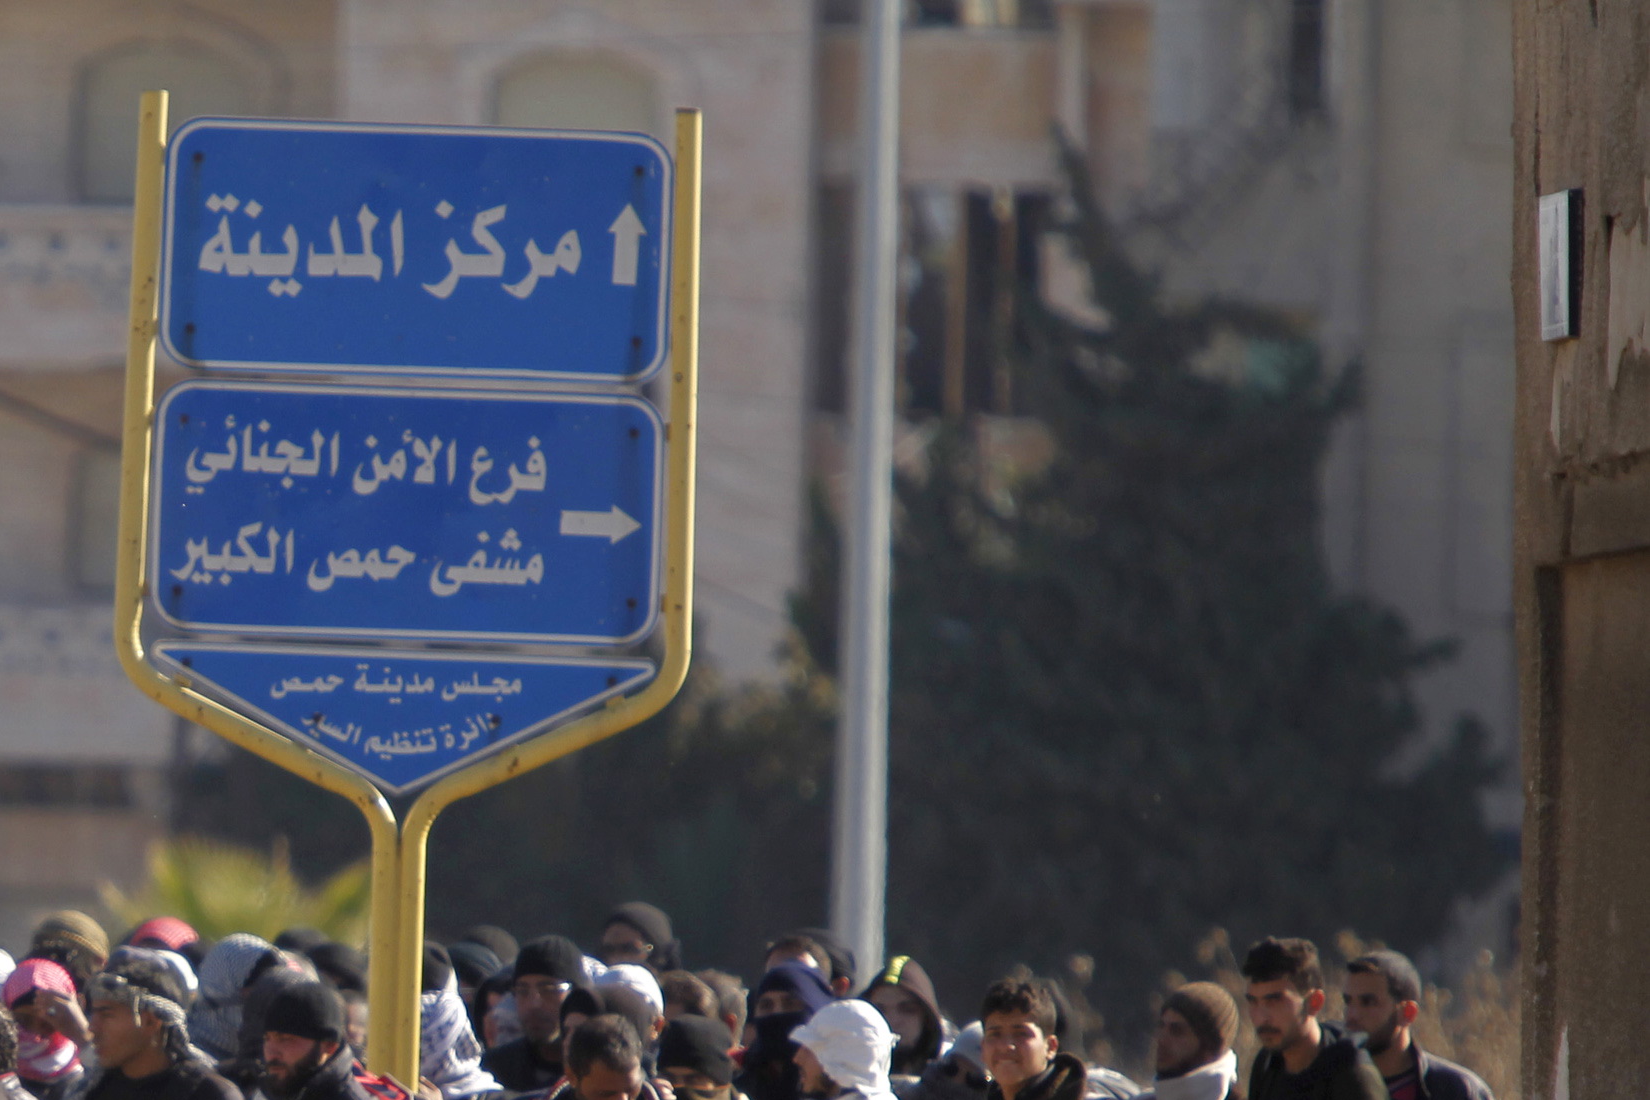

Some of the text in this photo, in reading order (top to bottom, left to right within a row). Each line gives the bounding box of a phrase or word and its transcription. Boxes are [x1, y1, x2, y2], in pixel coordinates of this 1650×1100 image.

[198, 193, 582, 300] مركز المدينة
[184, 414, 548, 506] فرع الأمن الجنائي
[169, 522, 545, 598] مشفى حمص الكبير
[269, 663, 523, 704] مجلس مدينة حمص
[362, 726, 438, 761] تنظيم
